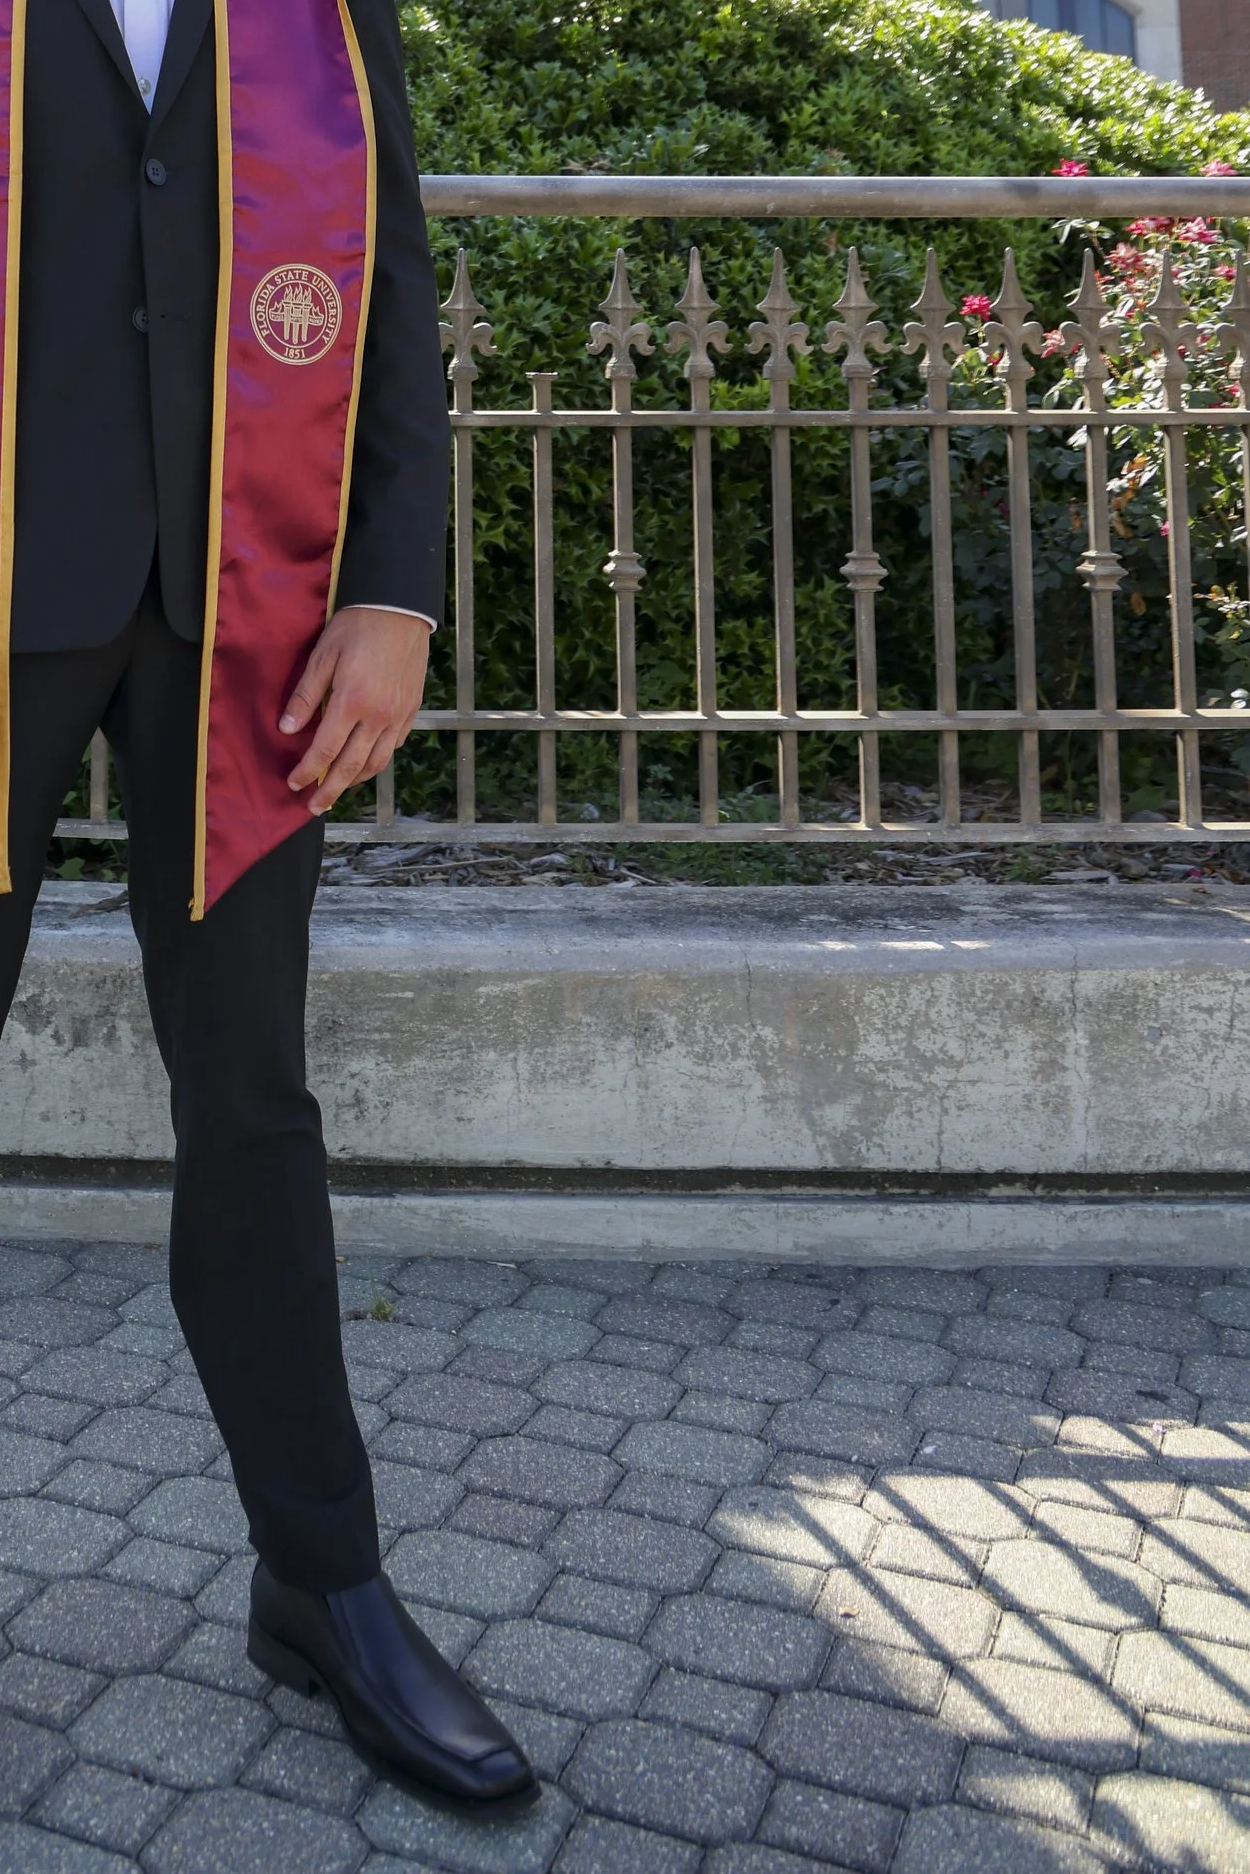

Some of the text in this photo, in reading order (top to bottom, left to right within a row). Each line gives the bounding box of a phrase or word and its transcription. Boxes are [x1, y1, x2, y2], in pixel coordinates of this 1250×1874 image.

[256, 269, 337, 344] FLORIDA STATE UNIVERSITY
[283, 347, 306, 359] 1851
